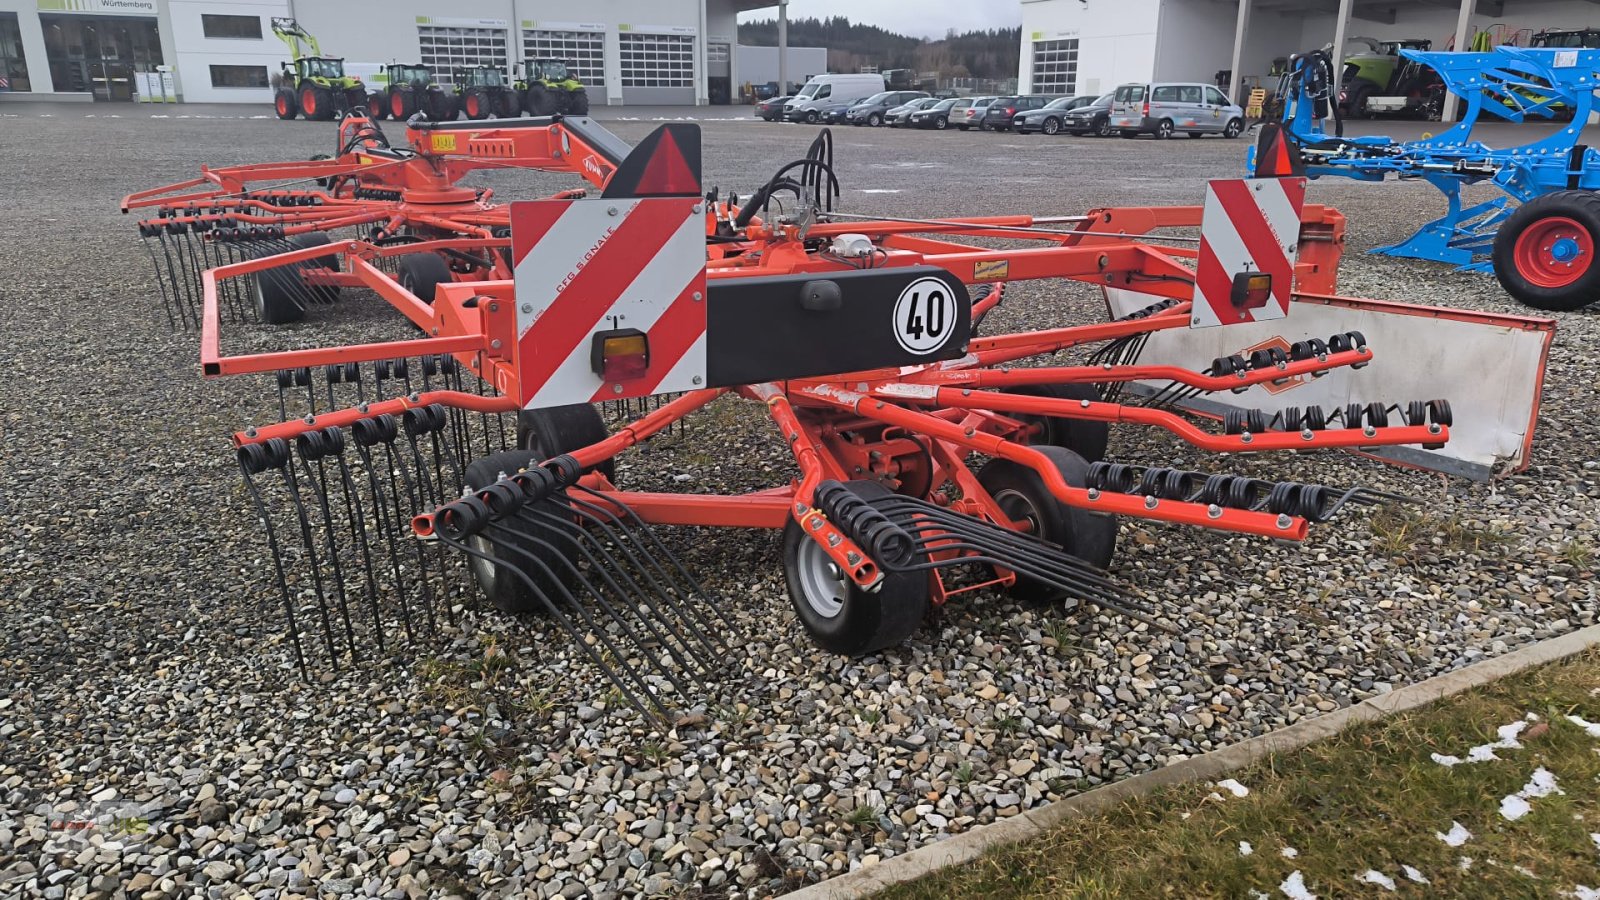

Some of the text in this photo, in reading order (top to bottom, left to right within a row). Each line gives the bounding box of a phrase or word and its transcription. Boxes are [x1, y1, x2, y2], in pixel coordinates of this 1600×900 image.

[1269, 223, 1285, 249] SGNALE
[556, 271, 576, 294] CFG
[906, 290, 945, 340] 40
